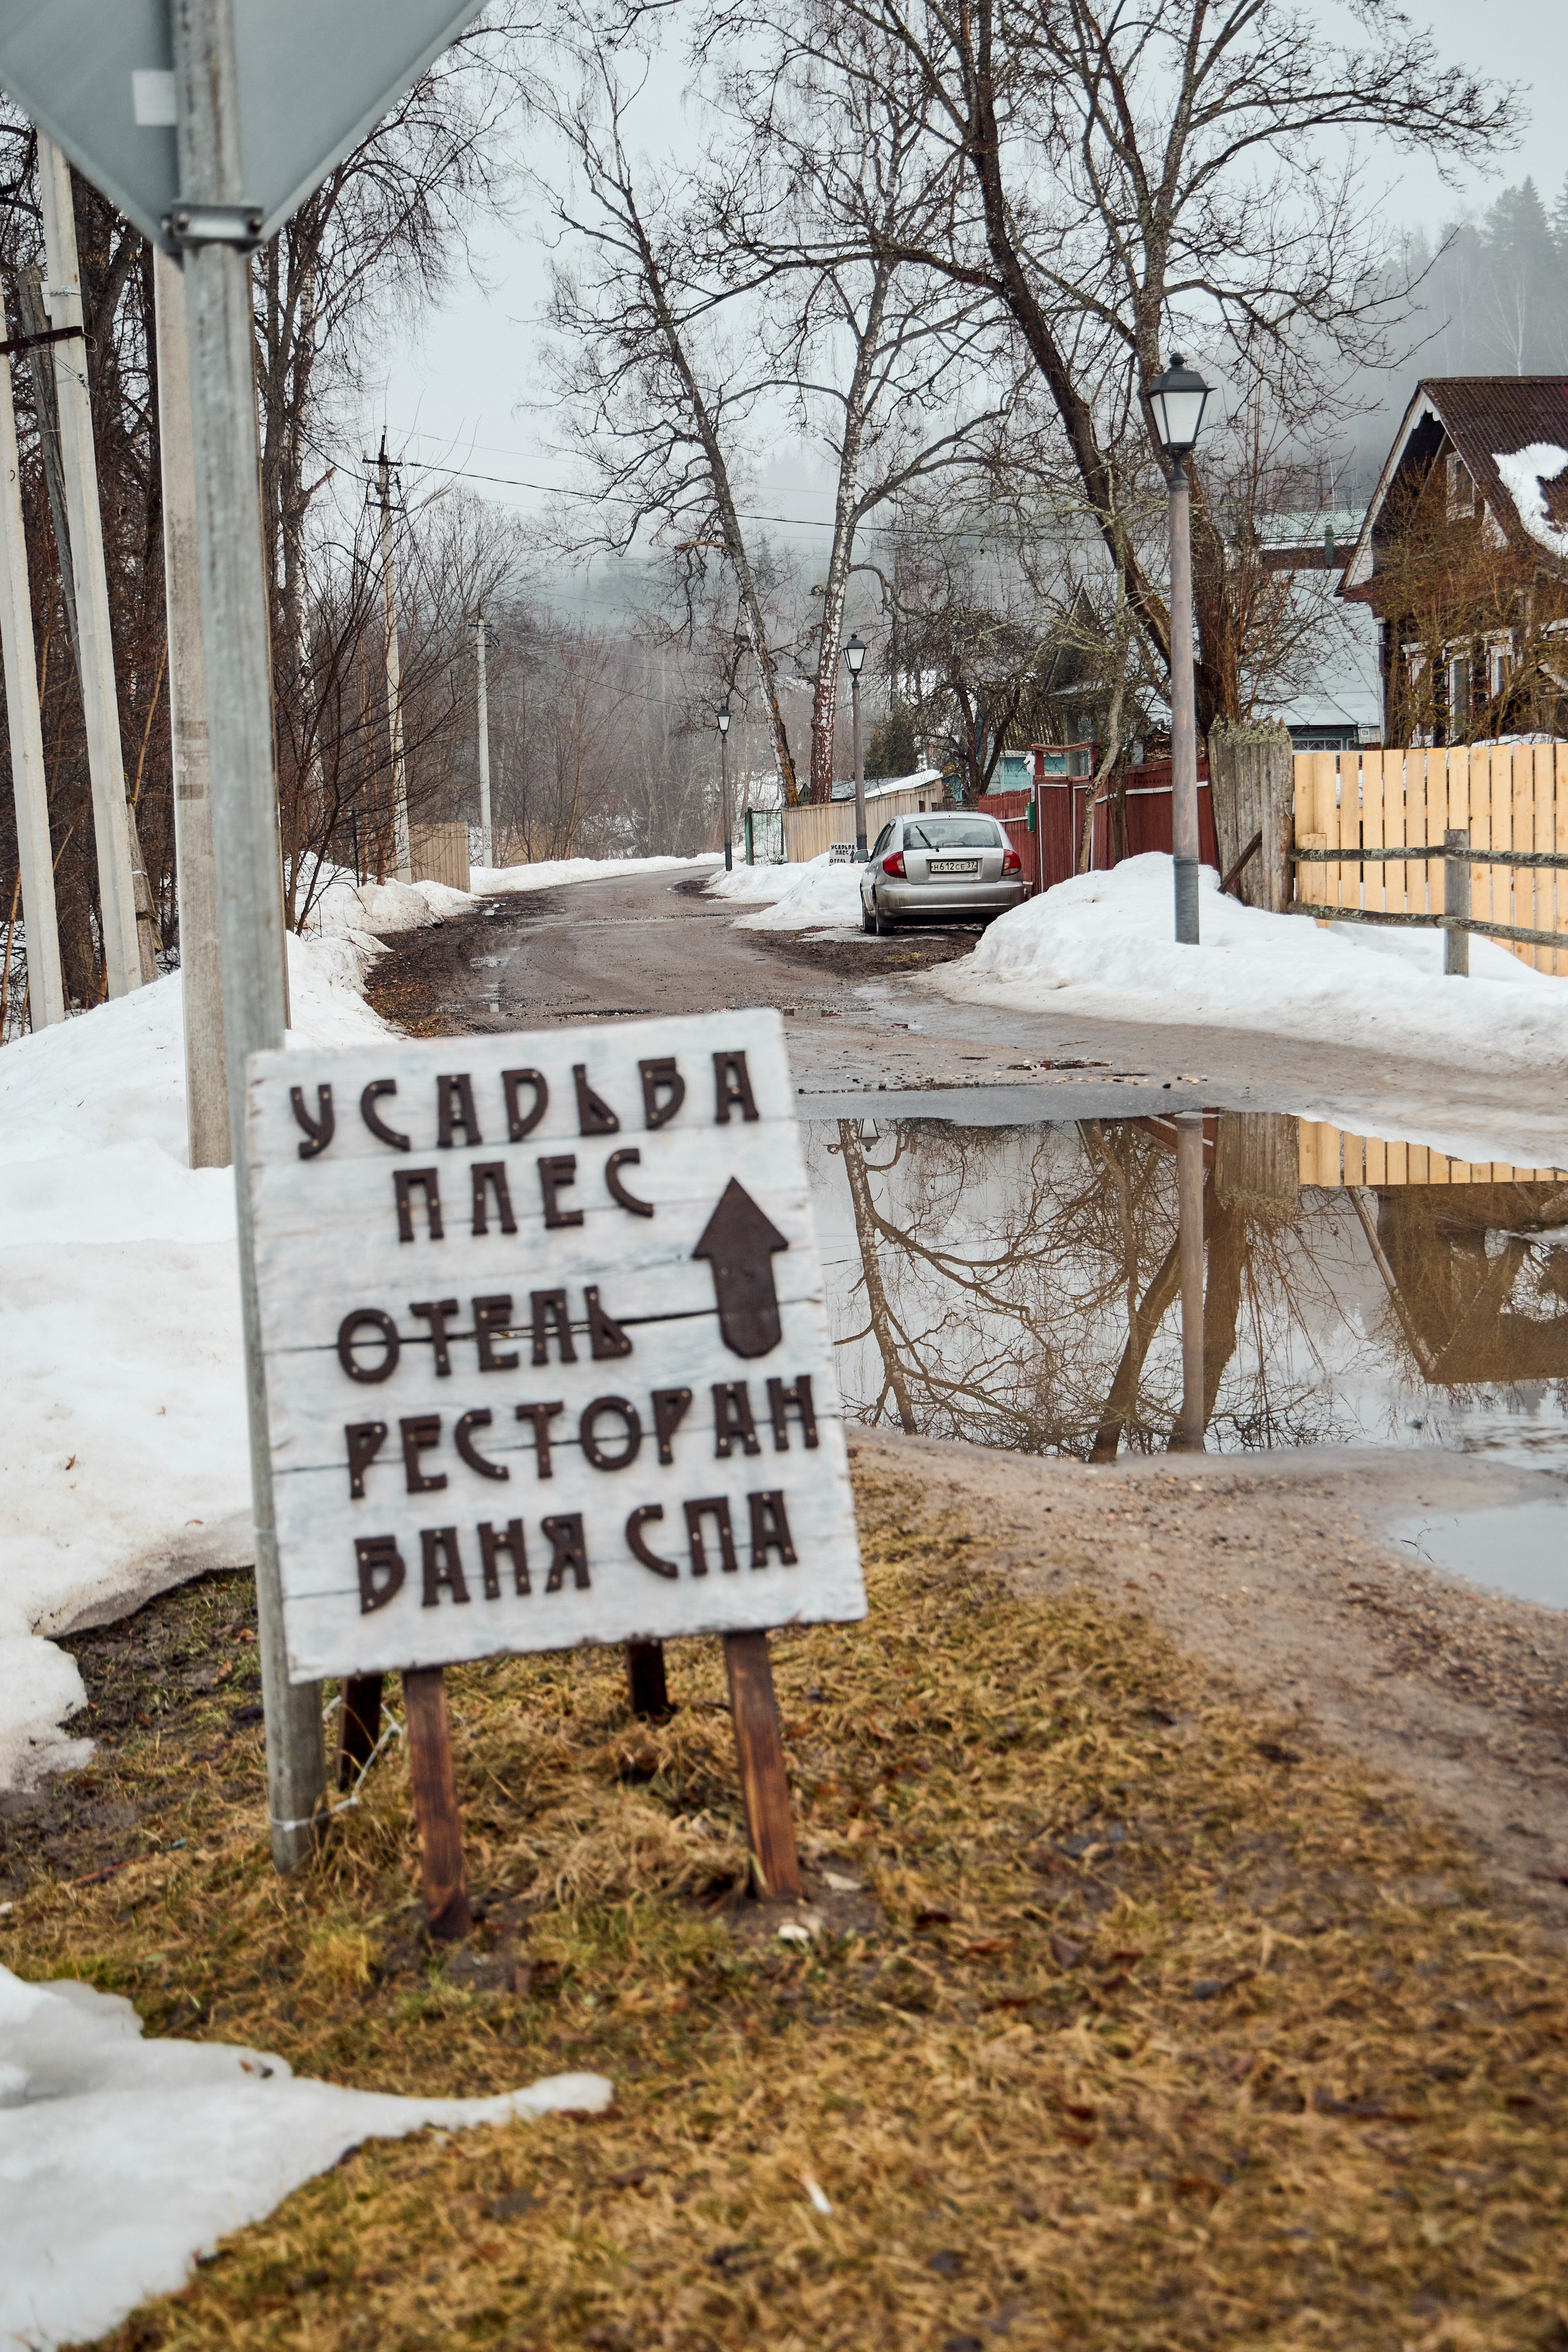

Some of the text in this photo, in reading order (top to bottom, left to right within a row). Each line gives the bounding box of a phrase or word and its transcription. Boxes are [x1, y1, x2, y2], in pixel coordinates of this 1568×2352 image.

[288, 1049, 760, 1162] УСАДЬБА
[392, 1147, 654, 1245] ПЛЕС
[337, 1284, 633, 1383] ОТЕЛЬ
[344, 1374, 820, 1501] РЕСТОРАН
[353, 1489, 798, 1616] БАНЯ СПА
